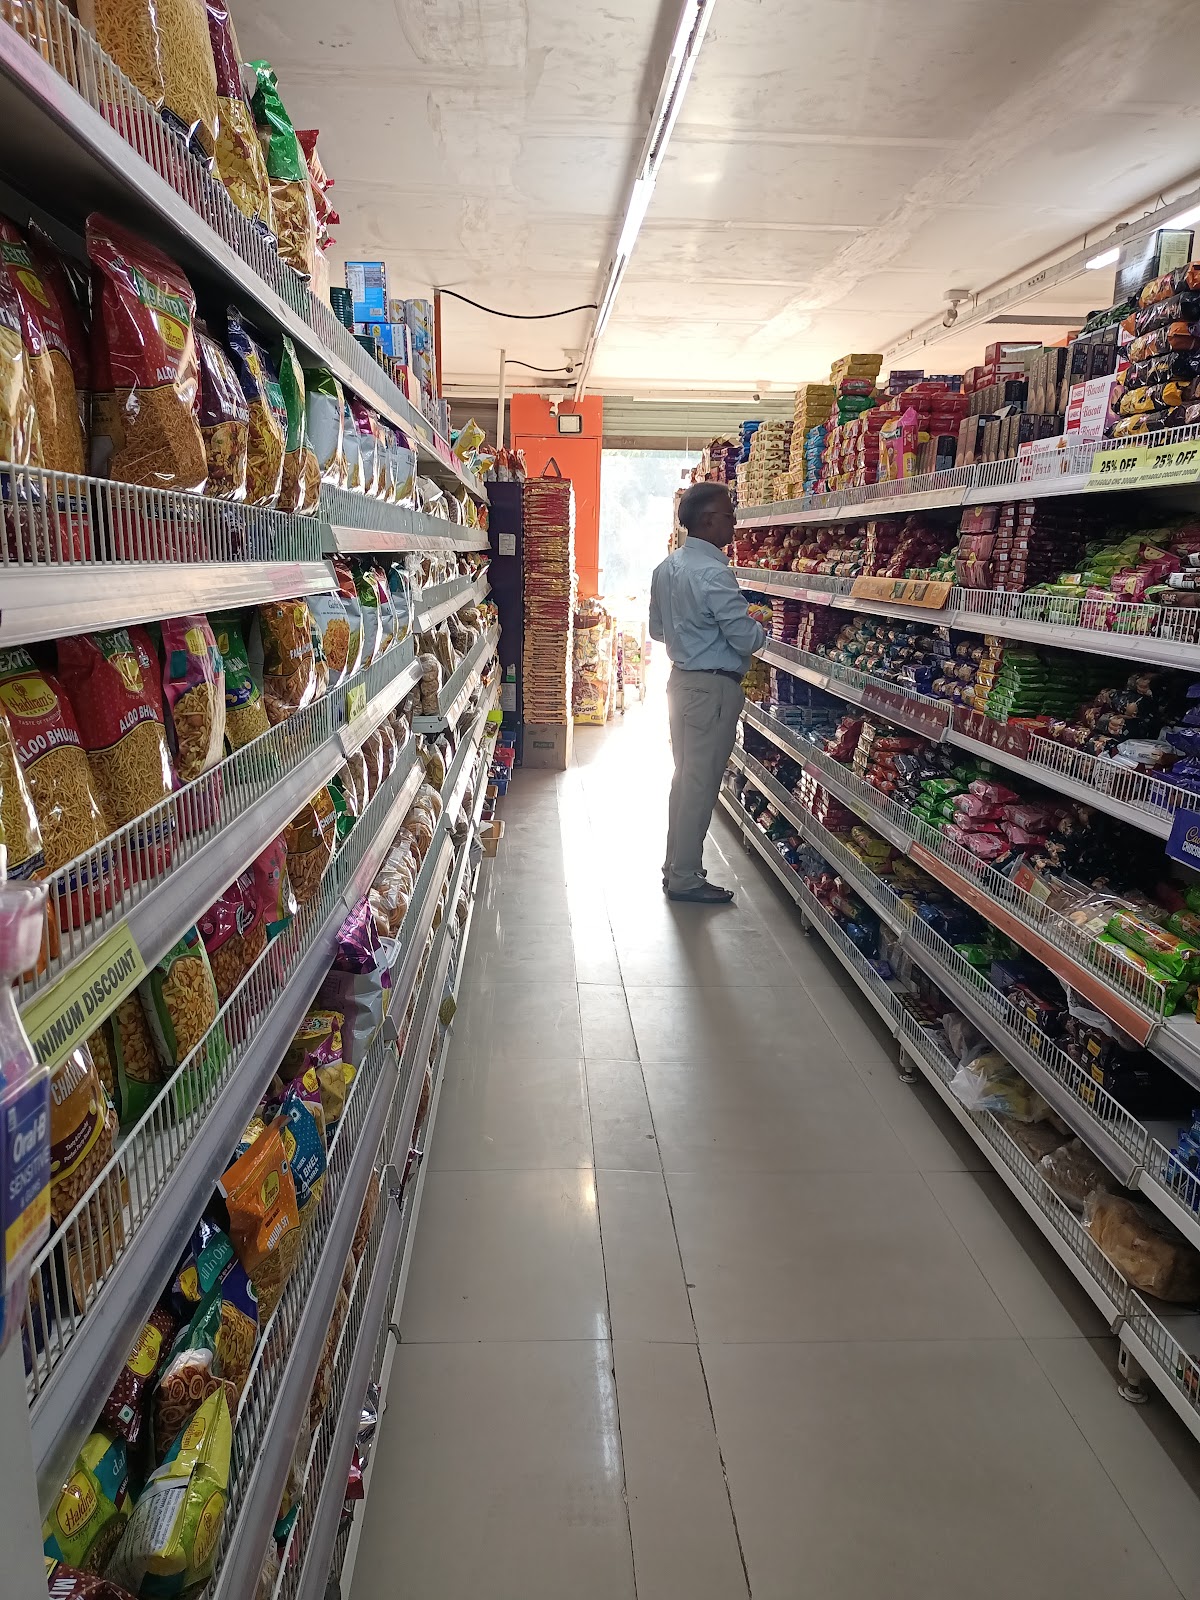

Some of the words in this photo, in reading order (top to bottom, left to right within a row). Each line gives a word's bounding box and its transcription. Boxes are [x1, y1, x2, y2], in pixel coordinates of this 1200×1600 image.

[157, 293, 188, 321] EXTRA
[156, 365, 178, 382] ALOO
[1100, 461, 1118, 473] 25%
[1120, 457, 1138, 472] OFF
[1152, 453, 1174, 469] 25%
[1175, 450, 1198, 466] OFF
[8, 691, 54, 714] Haldiram's
[119, 707, 138, 733] ALOO
[46, 727, 80, 746] BHUJIA
[32, 1000, 86, 1065] INIMUM
[82, 948, 137, 1016] DISCOUNT
[302, 1154, 319, 1177] BHEL
[112, 1450, 126, 1476] dal
[48, 1578, 78, 1600] MI
